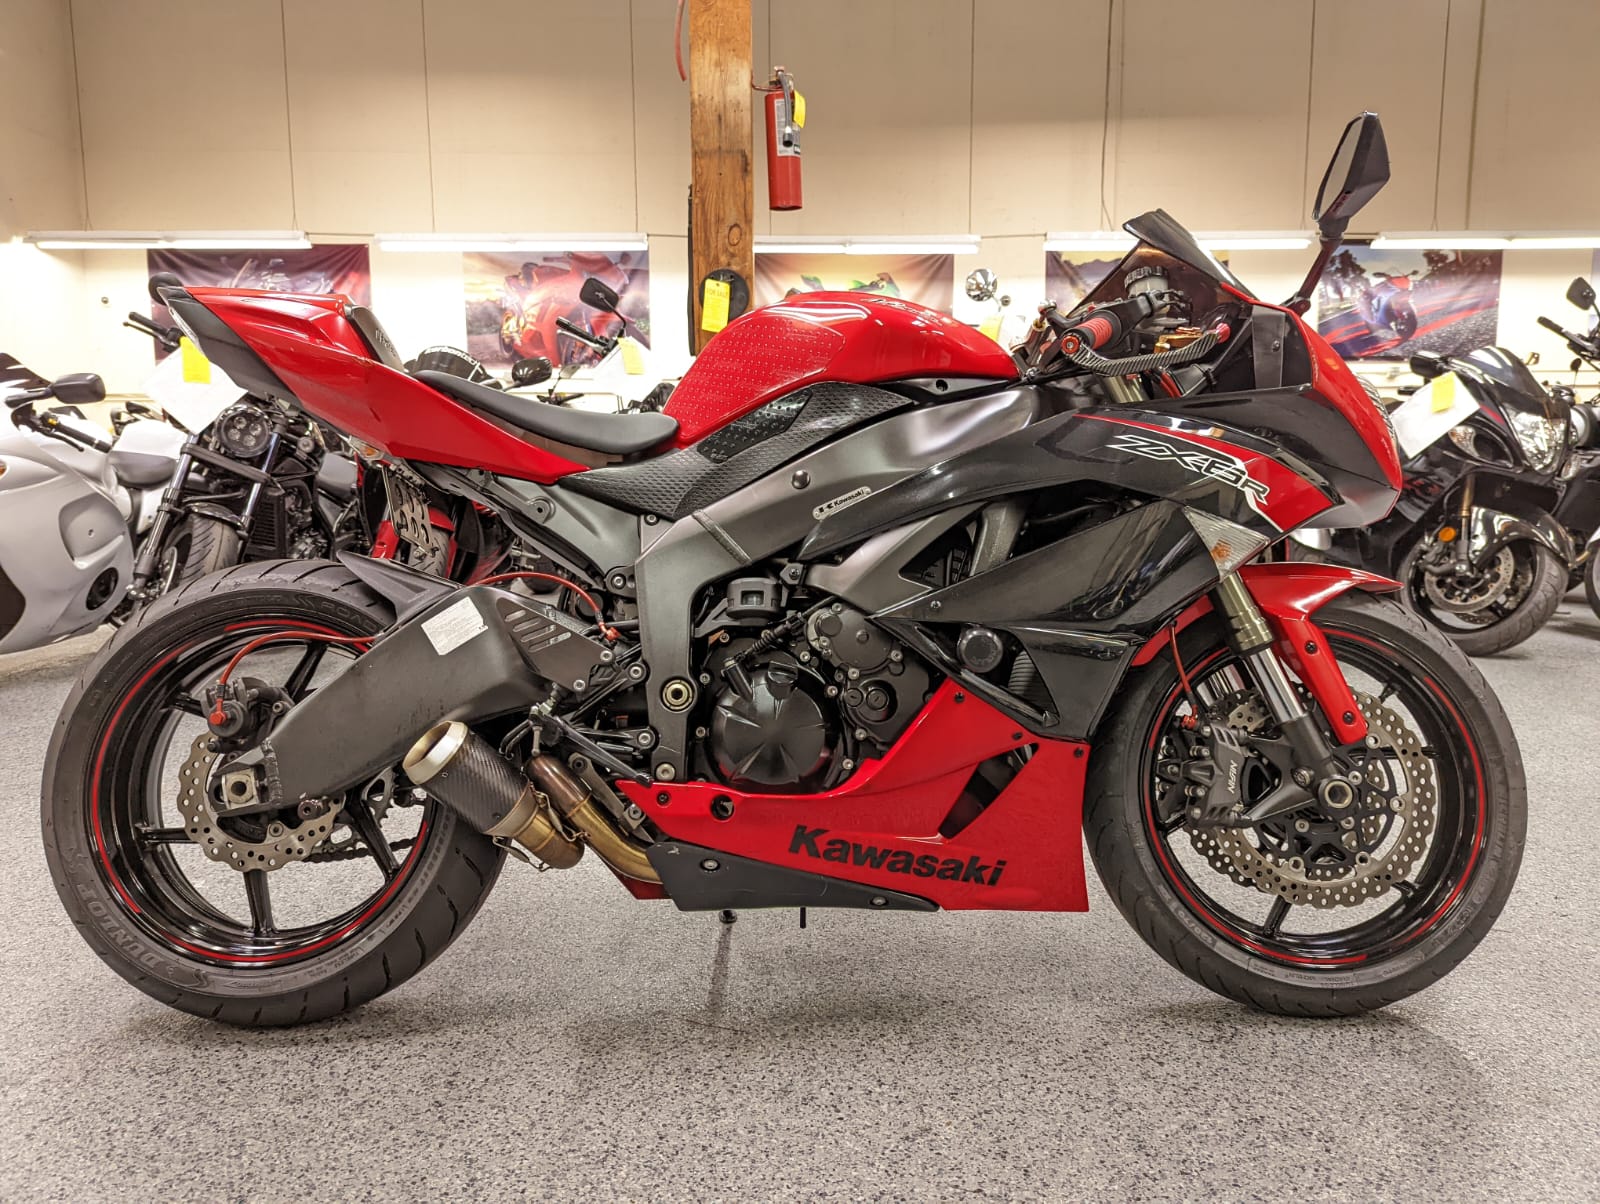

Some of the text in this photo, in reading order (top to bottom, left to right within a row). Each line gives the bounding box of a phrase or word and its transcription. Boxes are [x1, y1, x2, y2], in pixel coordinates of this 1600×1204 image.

[833, 489, 865, 507] Kawasaki
[788, 824, 1007, 887] Kawasaki
[76, 884, 166, 969] DUNLOP
